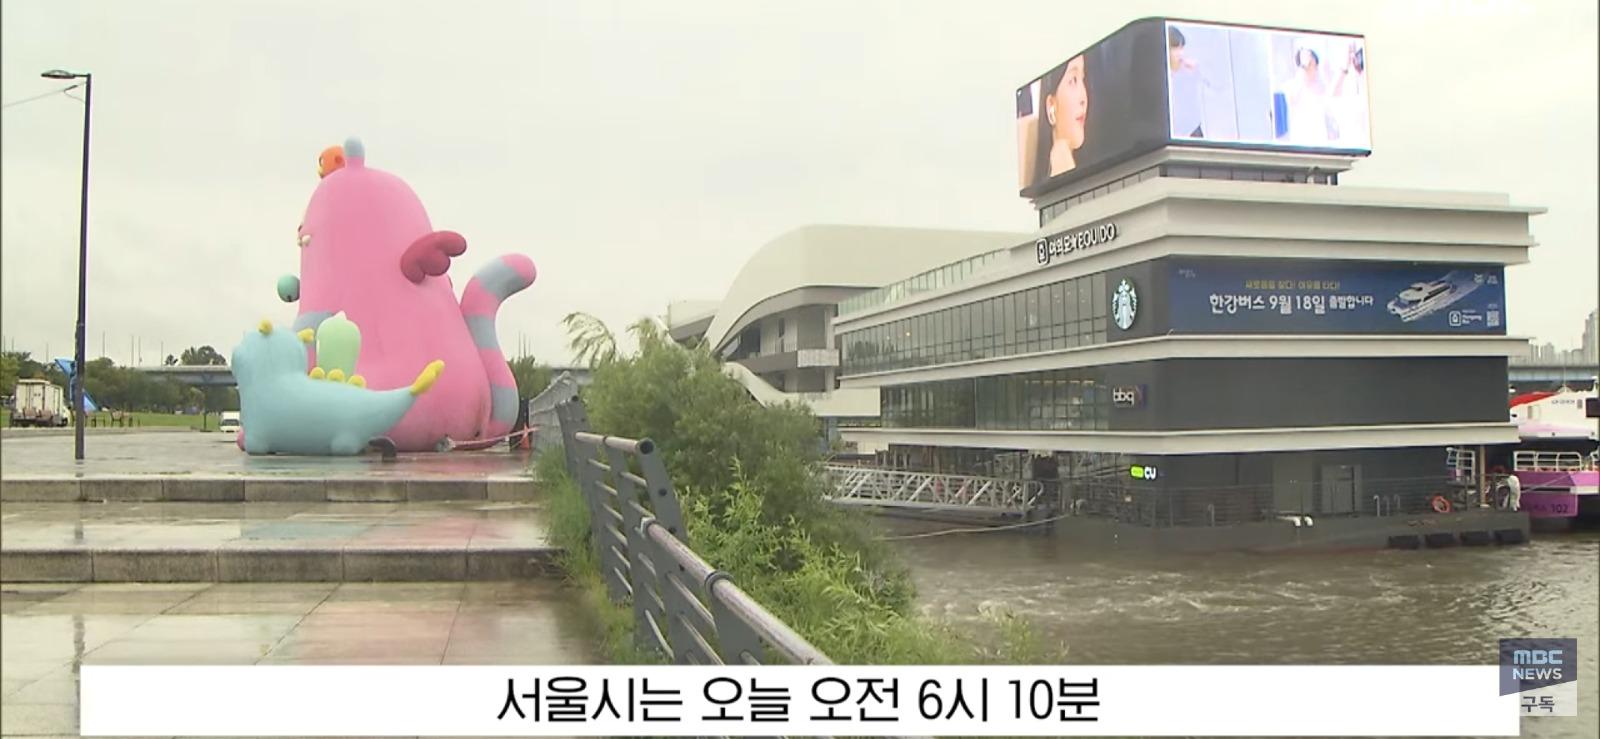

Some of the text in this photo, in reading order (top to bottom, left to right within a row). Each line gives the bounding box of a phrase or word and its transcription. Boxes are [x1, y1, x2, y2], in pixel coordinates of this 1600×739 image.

[1209, 294, 1266, 314] 한강버스
[1269, 295, 1292, 314] 9월
[1295, 295, 1326, 315] 18일
[1113, 386, 1135, 406] bbq
[1144, 466, 1157, 480] CU
